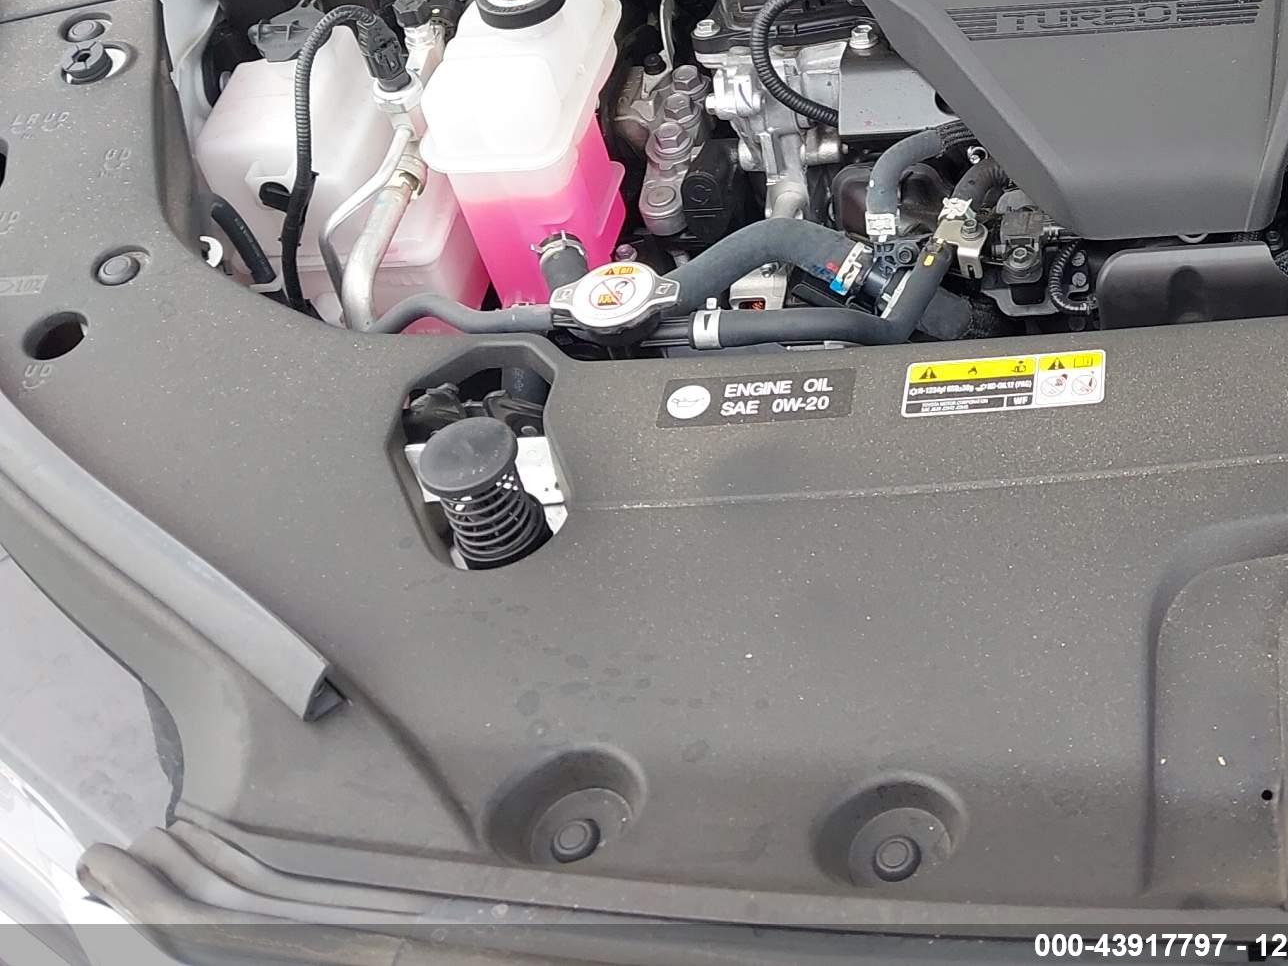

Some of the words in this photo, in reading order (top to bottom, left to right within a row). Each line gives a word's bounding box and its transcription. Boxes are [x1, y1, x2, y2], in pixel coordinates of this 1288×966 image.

[1002, 1, 1173, 32] TURBO
[724, 380, 792, 397] ENGINE
[803, 378, 833, 392] OIL
[720, 400, 760, 416] SAE
[772, 396, 829, 413] 0W-20
